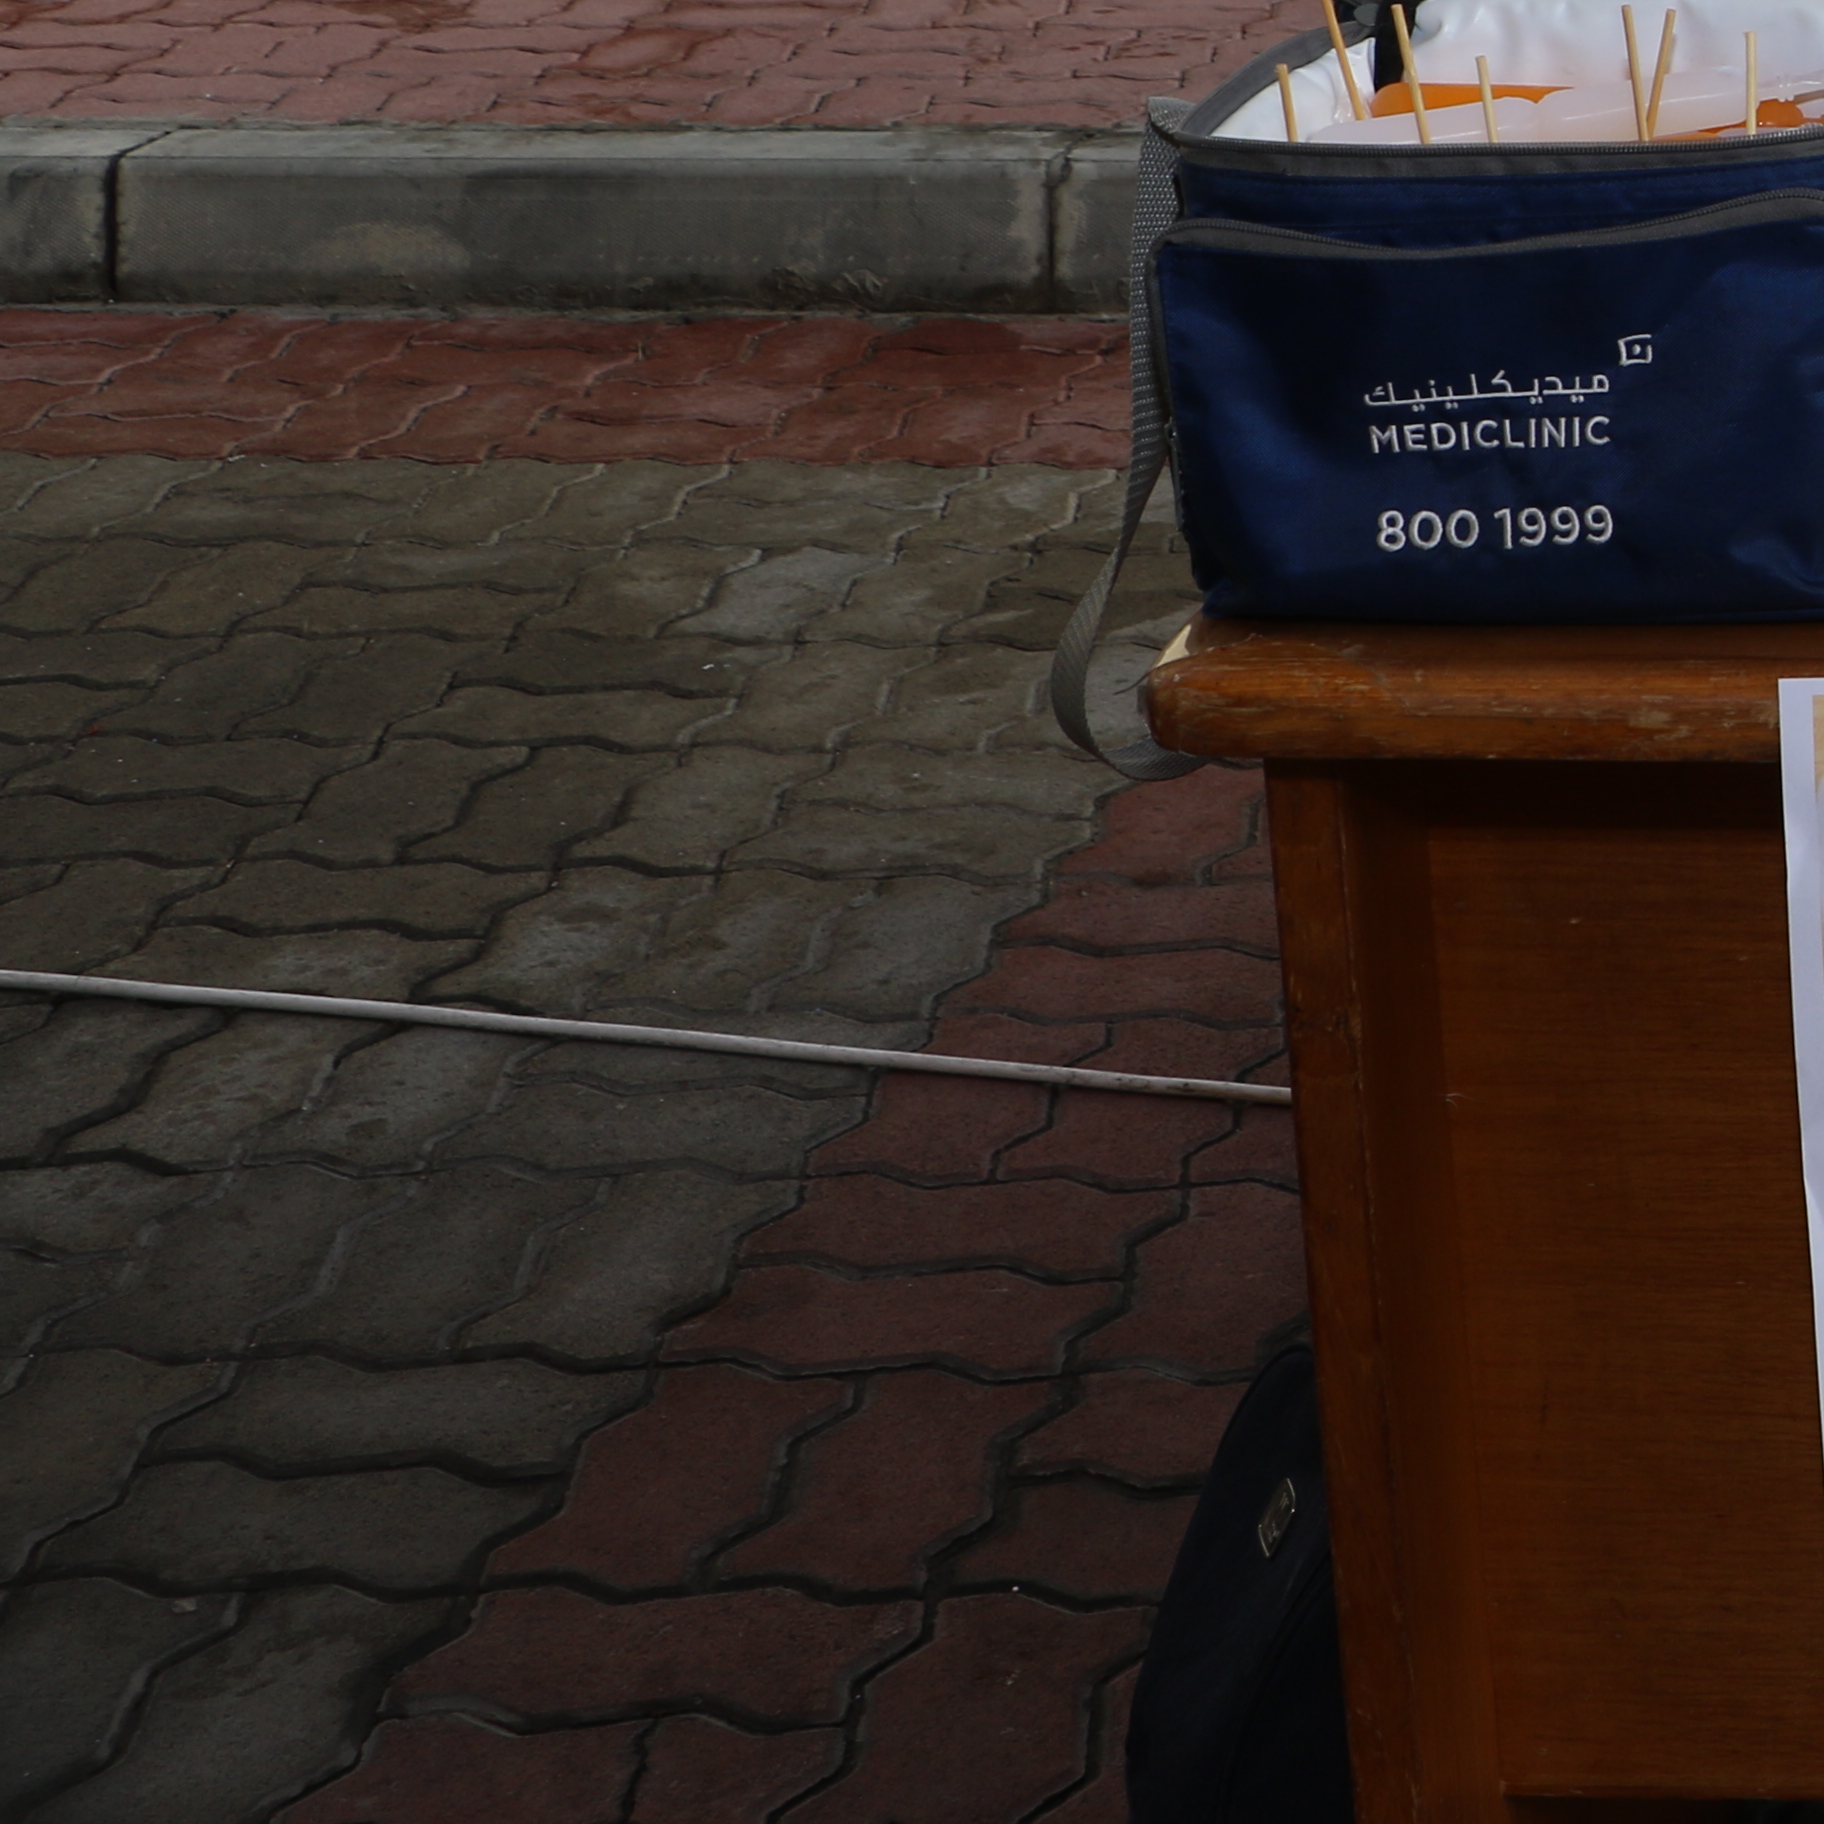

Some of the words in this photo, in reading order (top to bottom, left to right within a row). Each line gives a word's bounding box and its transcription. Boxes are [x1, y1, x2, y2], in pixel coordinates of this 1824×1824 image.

[1369, 415, 1610, 454] MEDICLINIC
[1377, 509, 1479, 551] 800
[1493, 504, 1613, 550] 1999
